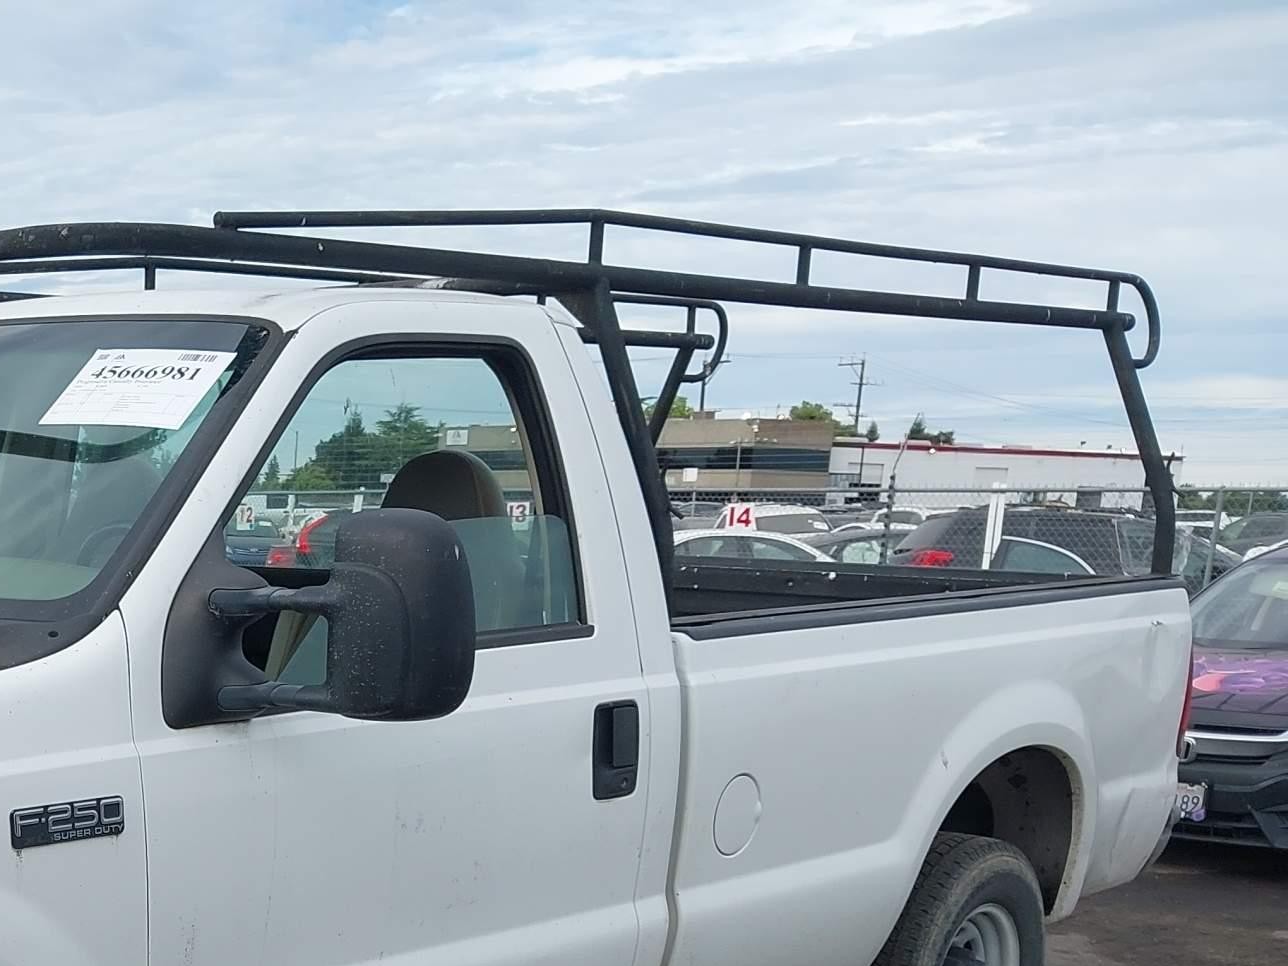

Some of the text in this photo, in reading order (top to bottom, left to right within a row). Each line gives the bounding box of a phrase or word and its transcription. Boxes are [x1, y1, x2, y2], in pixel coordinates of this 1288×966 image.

[90, 365, 202, 381] 45666981
[509, 504, 527, 523] 13
[728, 506, 752, 528] 14
[53, 823, 124, 841] SUPER DUTY
